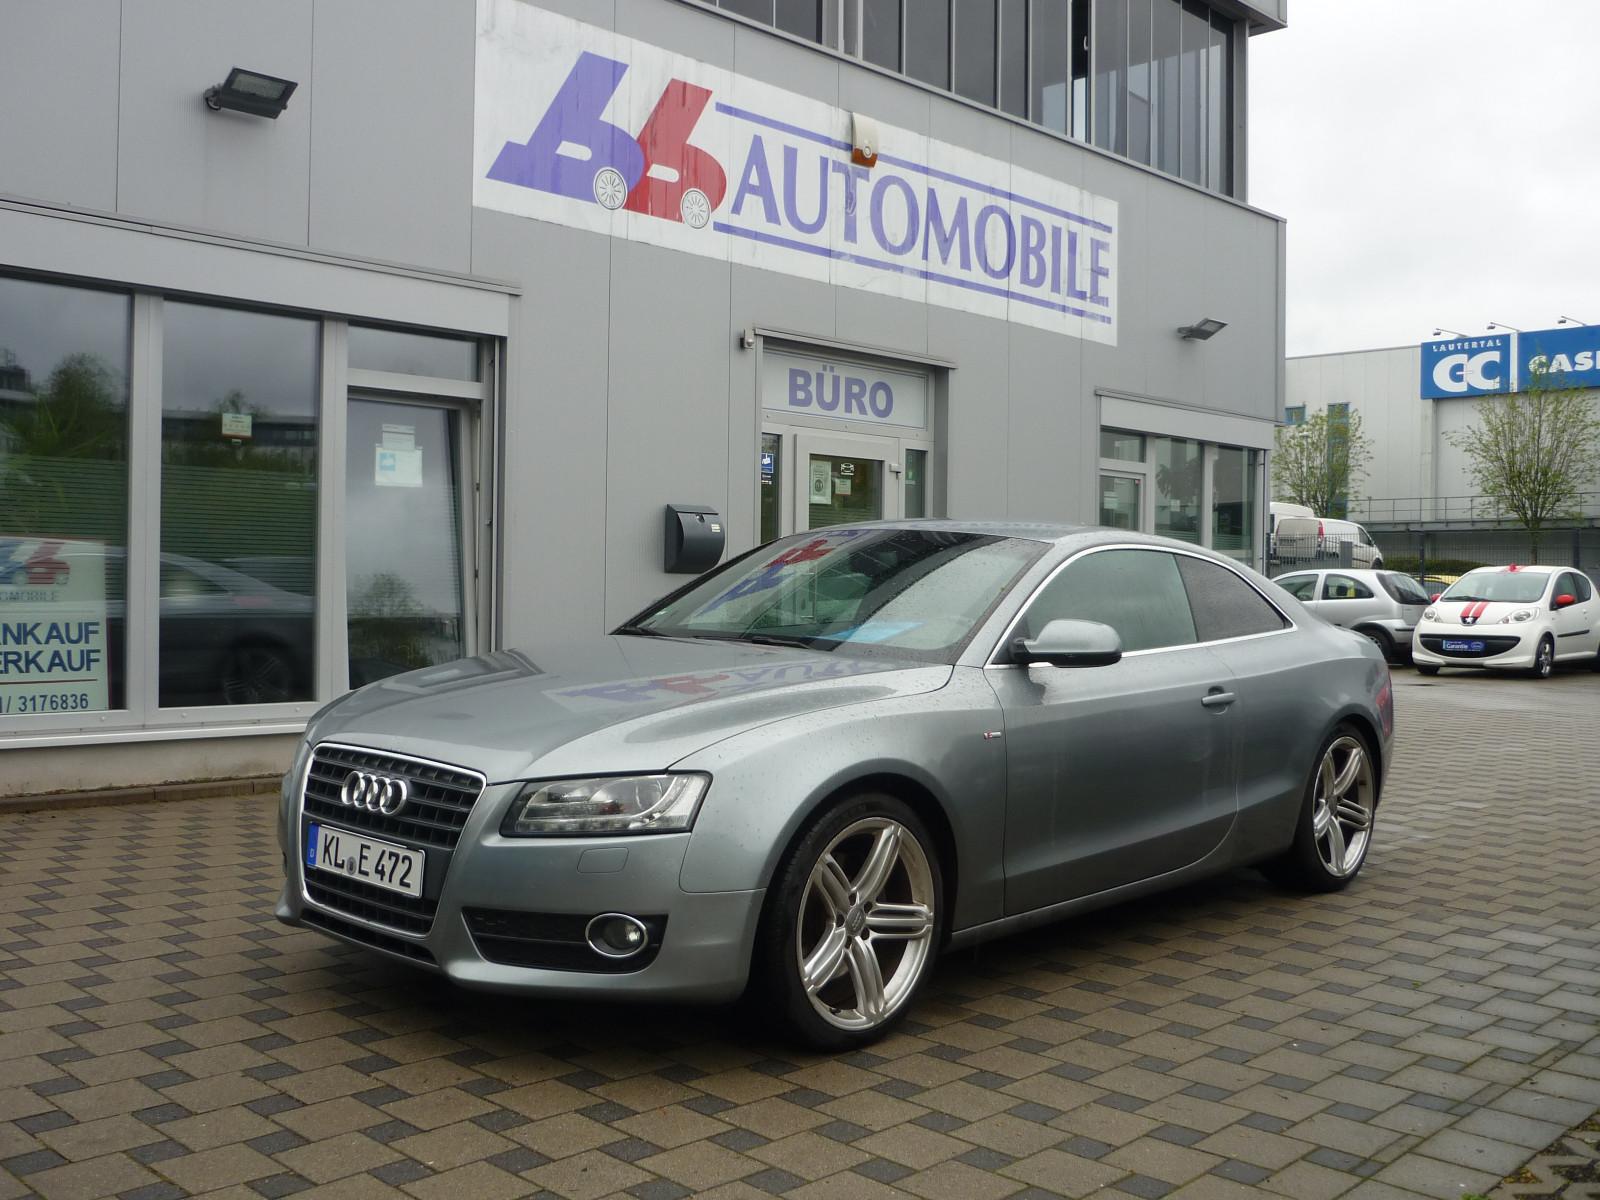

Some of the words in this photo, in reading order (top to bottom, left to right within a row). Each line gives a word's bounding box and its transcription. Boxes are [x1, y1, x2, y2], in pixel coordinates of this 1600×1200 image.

[731, 134, 1110, 307] AUTOMOBILE
[1432, 339, 1502, 352] LAUTERTAL
[788, 364, 894, 419] BÜRO
[0, 622, 99, 645] NKAUF
[18, 693, 89, 712] 3176836
[322, 833, 345, 870] KL
[358, 843, 372, 877] E
[374, 849, 413, 889] 472
